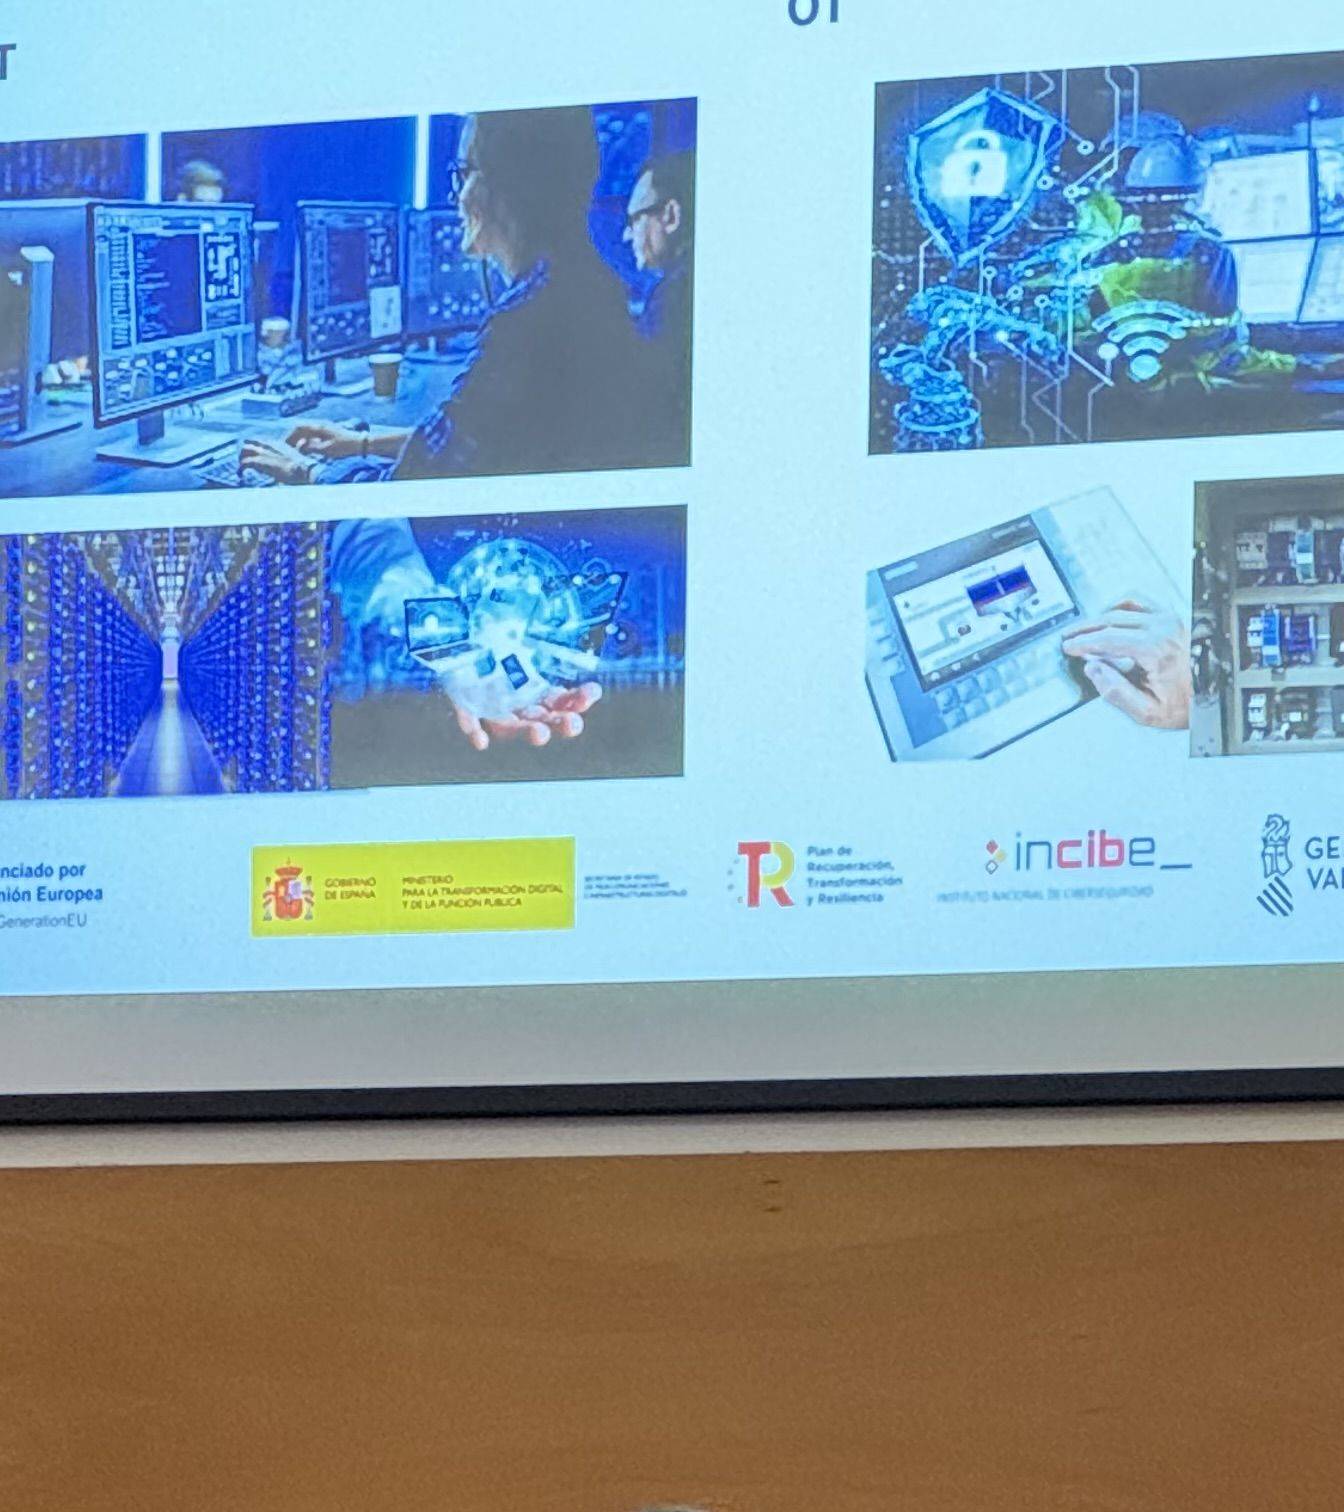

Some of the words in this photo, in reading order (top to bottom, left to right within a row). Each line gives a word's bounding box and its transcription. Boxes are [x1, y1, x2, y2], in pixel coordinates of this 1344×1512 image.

[806, 845, 834, 857] Plan
[837, 845, 853, 856] de
[59, 863, 87, 881] por
[806, 876, 904, 888] Transformación
[36, 885, 104, 905] Europea
[818, 892, 885, 905] Resiliencia
